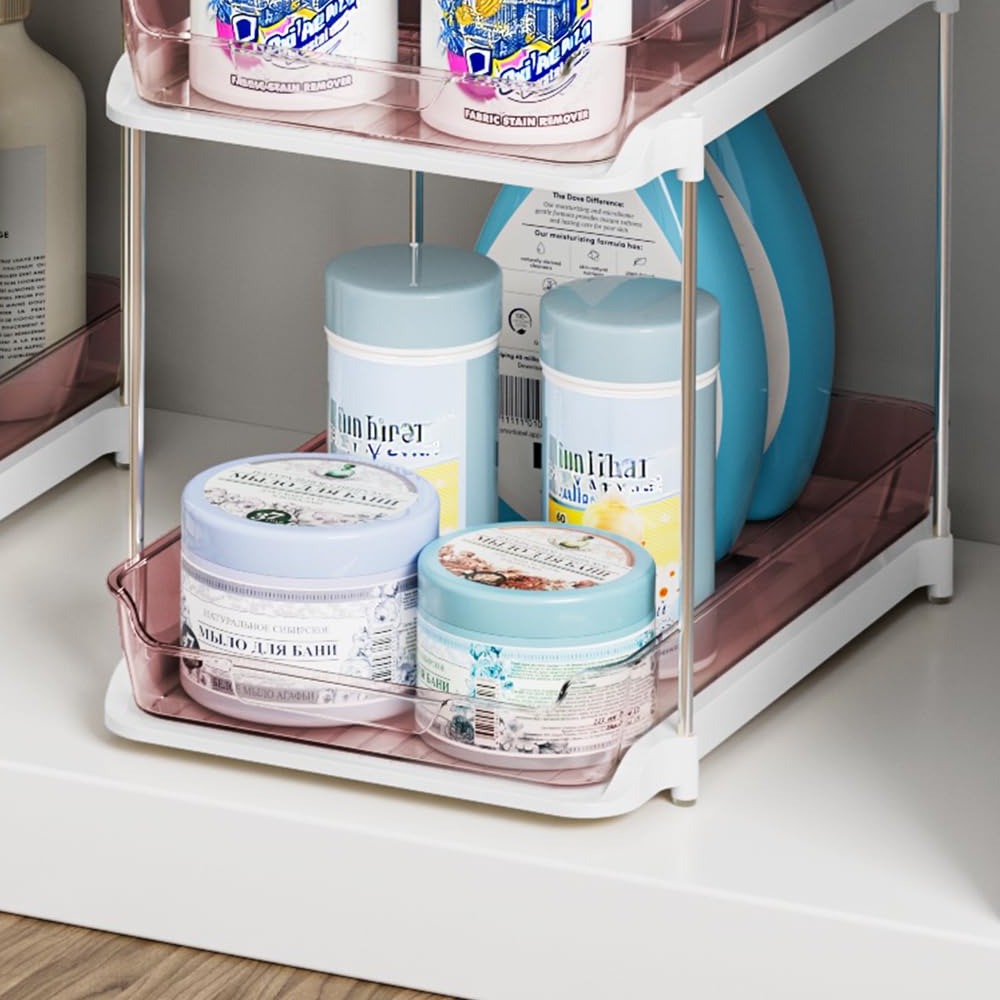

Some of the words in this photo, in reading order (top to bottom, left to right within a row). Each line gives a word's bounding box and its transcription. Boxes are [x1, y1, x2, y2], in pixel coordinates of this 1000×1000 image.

[303, 74, 353, 93] REMOVER
[464, 107, 501, 126] FABRIC
[502, 114, 537, 127] STAIN
[538, 109, 589, 127] REMOVER
[552, 191, 566, 200] The
[567, 193, 584, 203] Dove
[534, 229, 548, 238] Our
[549, 232, 596, 246] moisturizing
[597, 237, 626, 249] formula
[199, 624, 248, 651] МЫЛО
[251, 641, 287, 656] ДЛЯ
[293, 644, 338, 657] БАНИ
